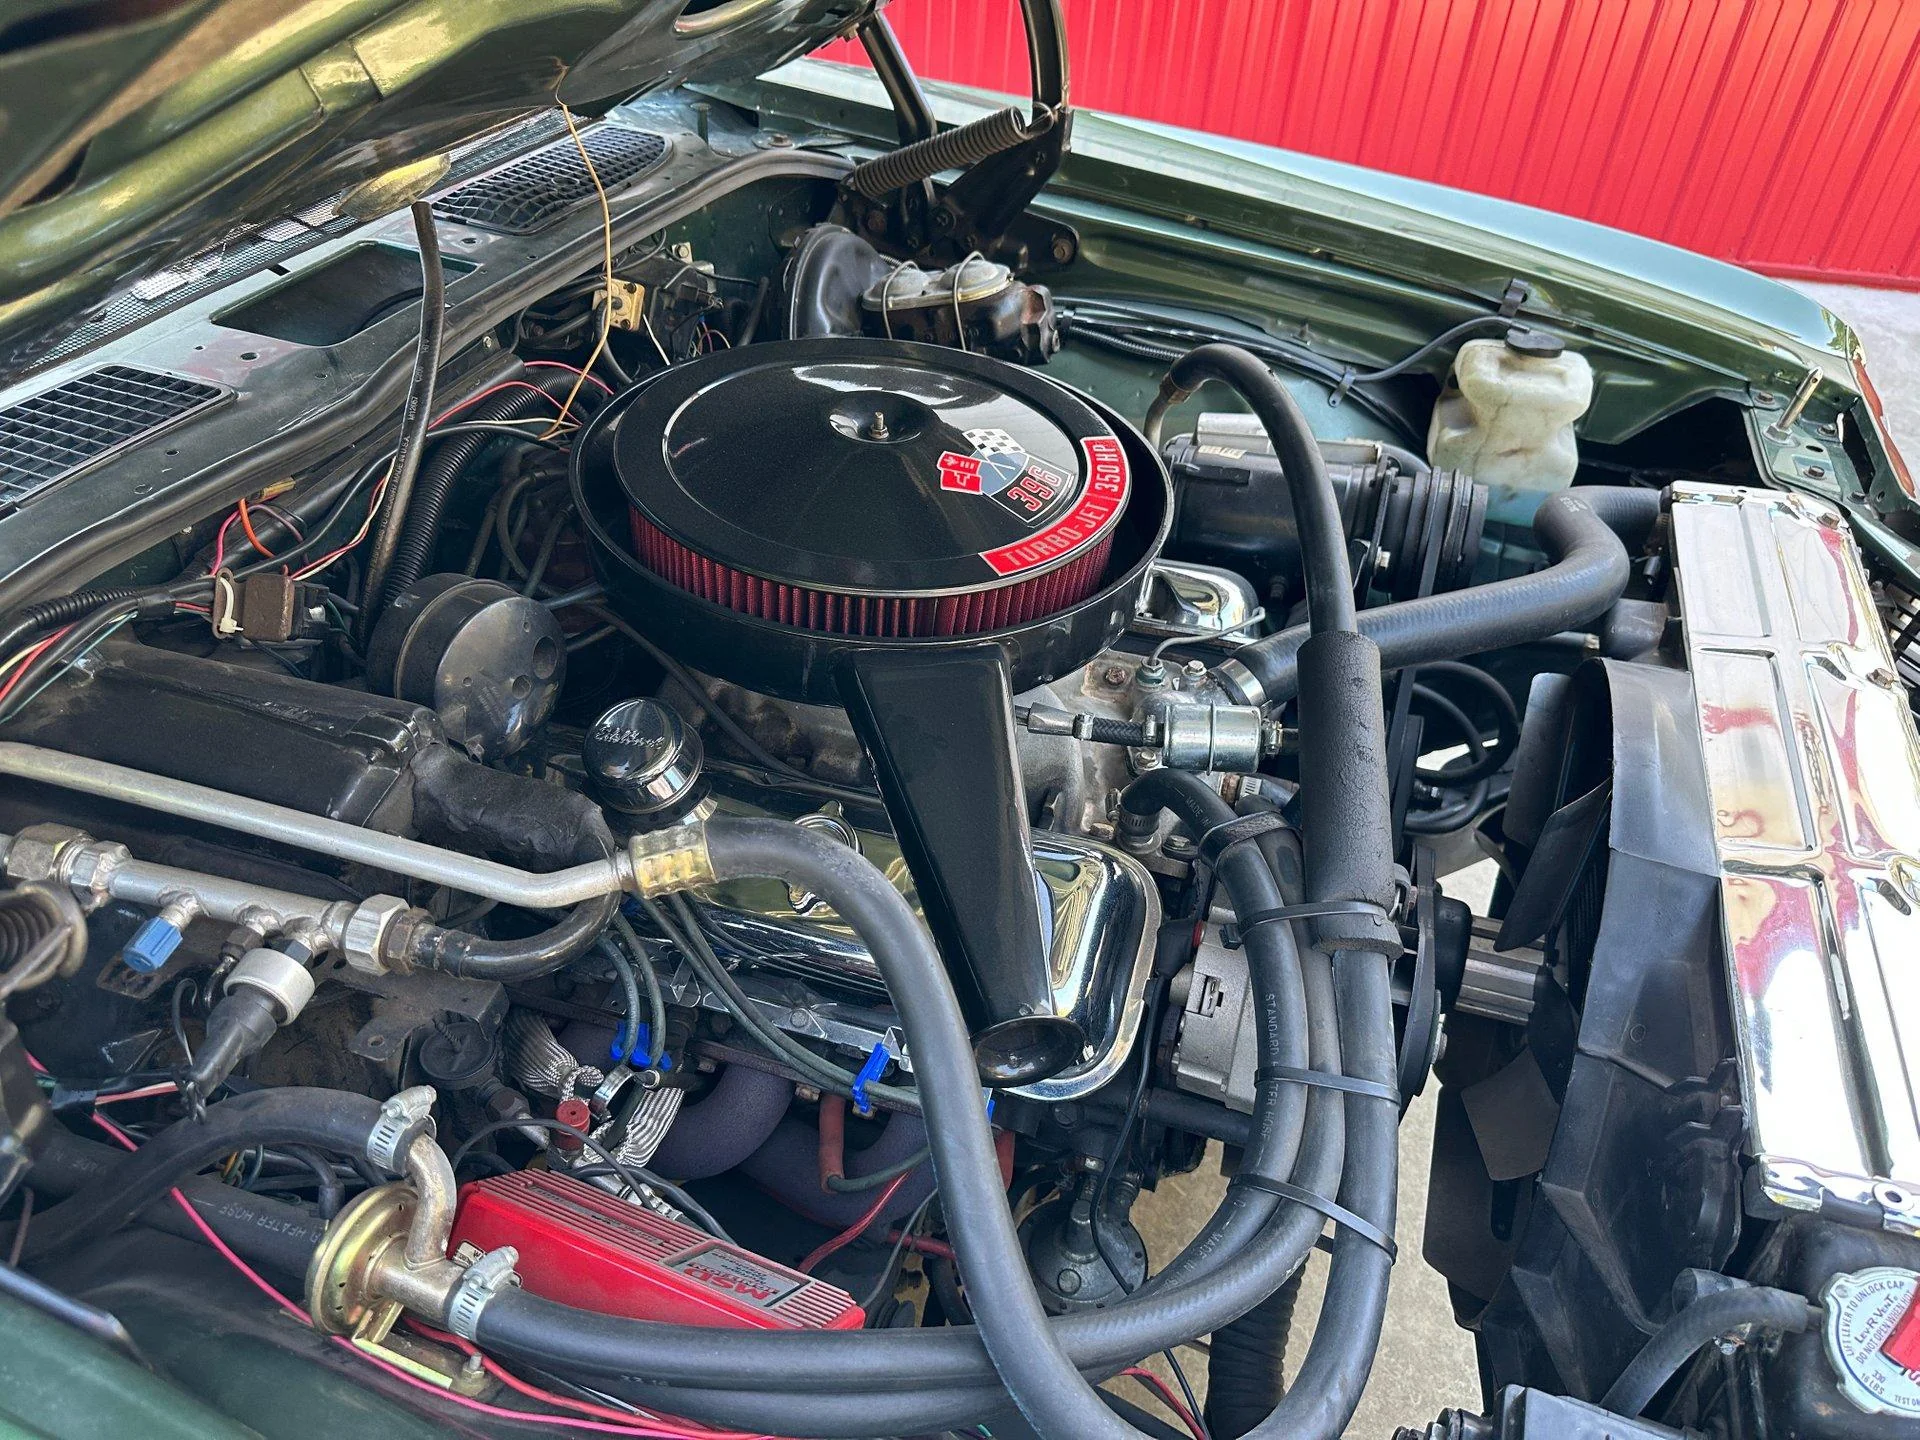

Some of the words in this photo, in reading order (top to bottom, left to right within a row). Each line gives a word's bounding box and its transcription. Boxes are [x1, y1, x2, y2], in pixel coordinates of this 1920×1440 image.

[1094, 443, 1118, 464] HP
[1007, 465, 1062, 511] 396
[1095, 466, 1121, 493] 350
[1002, 501, 1109, 566] TURBO-JET
[1265, 993, 1280, 1055] STANDARD
[1261, 1111, 1275, 1141] HOSE
[218, 1205, 254, 1221] HOSE
[257, 1214, 307, 1238] HEATER
[1199, 1231, 1223, 1259] MADE
[684, 1267, 770, 1300] MSD
[1841, 1312, 1853, 1337] LEVER
[1847, 1300, 1858, 1311] TO
[1855, 1282, 1885, 1302] UNLOCK
[1887, 1280, 1904, 1289] CAP
[1856, 1352, 1867, 1364] DO
[1863, 1338, 1878, 1354] NOT
[1873, 1322, 1890, 1341] OPEN
[1886, 1304, 1905, 1324] WHEN
[1900, 1291, 1914, 1307] HOT
[1861, 1373, 1870, 1383] 16
[1869, 1380, 1885, 1395] LBS
[1895, 1395, 1910, 1405] TEST
